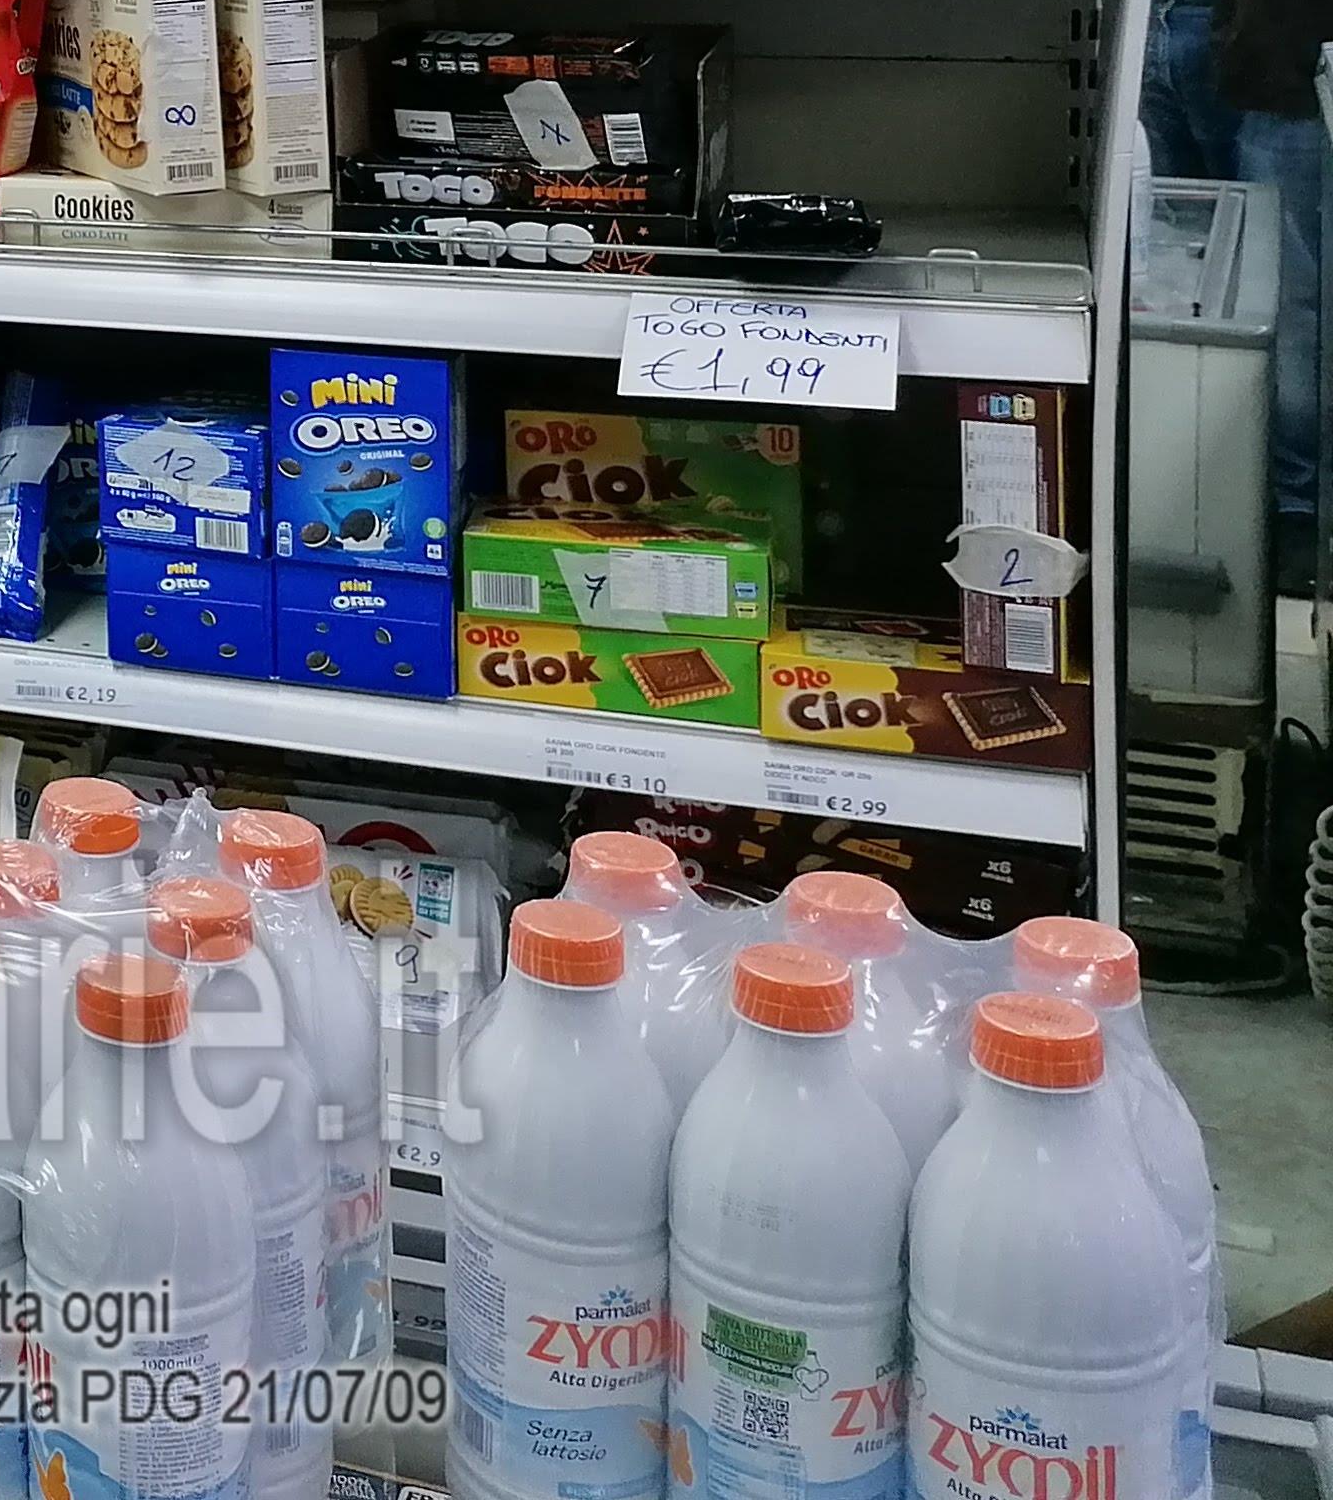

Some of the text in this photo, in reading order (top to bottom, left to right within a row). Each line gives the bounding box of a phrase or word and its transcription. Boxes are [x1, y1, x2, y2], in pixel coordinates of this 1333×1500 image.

[375, 171, 496, 203] TOGO
[54, 193, 134, 222] Cookies
[632, 312, 726, 342] TOGO
[295, 416, 435, 444] OREO
[479, 649, 603, 688] Ciok
